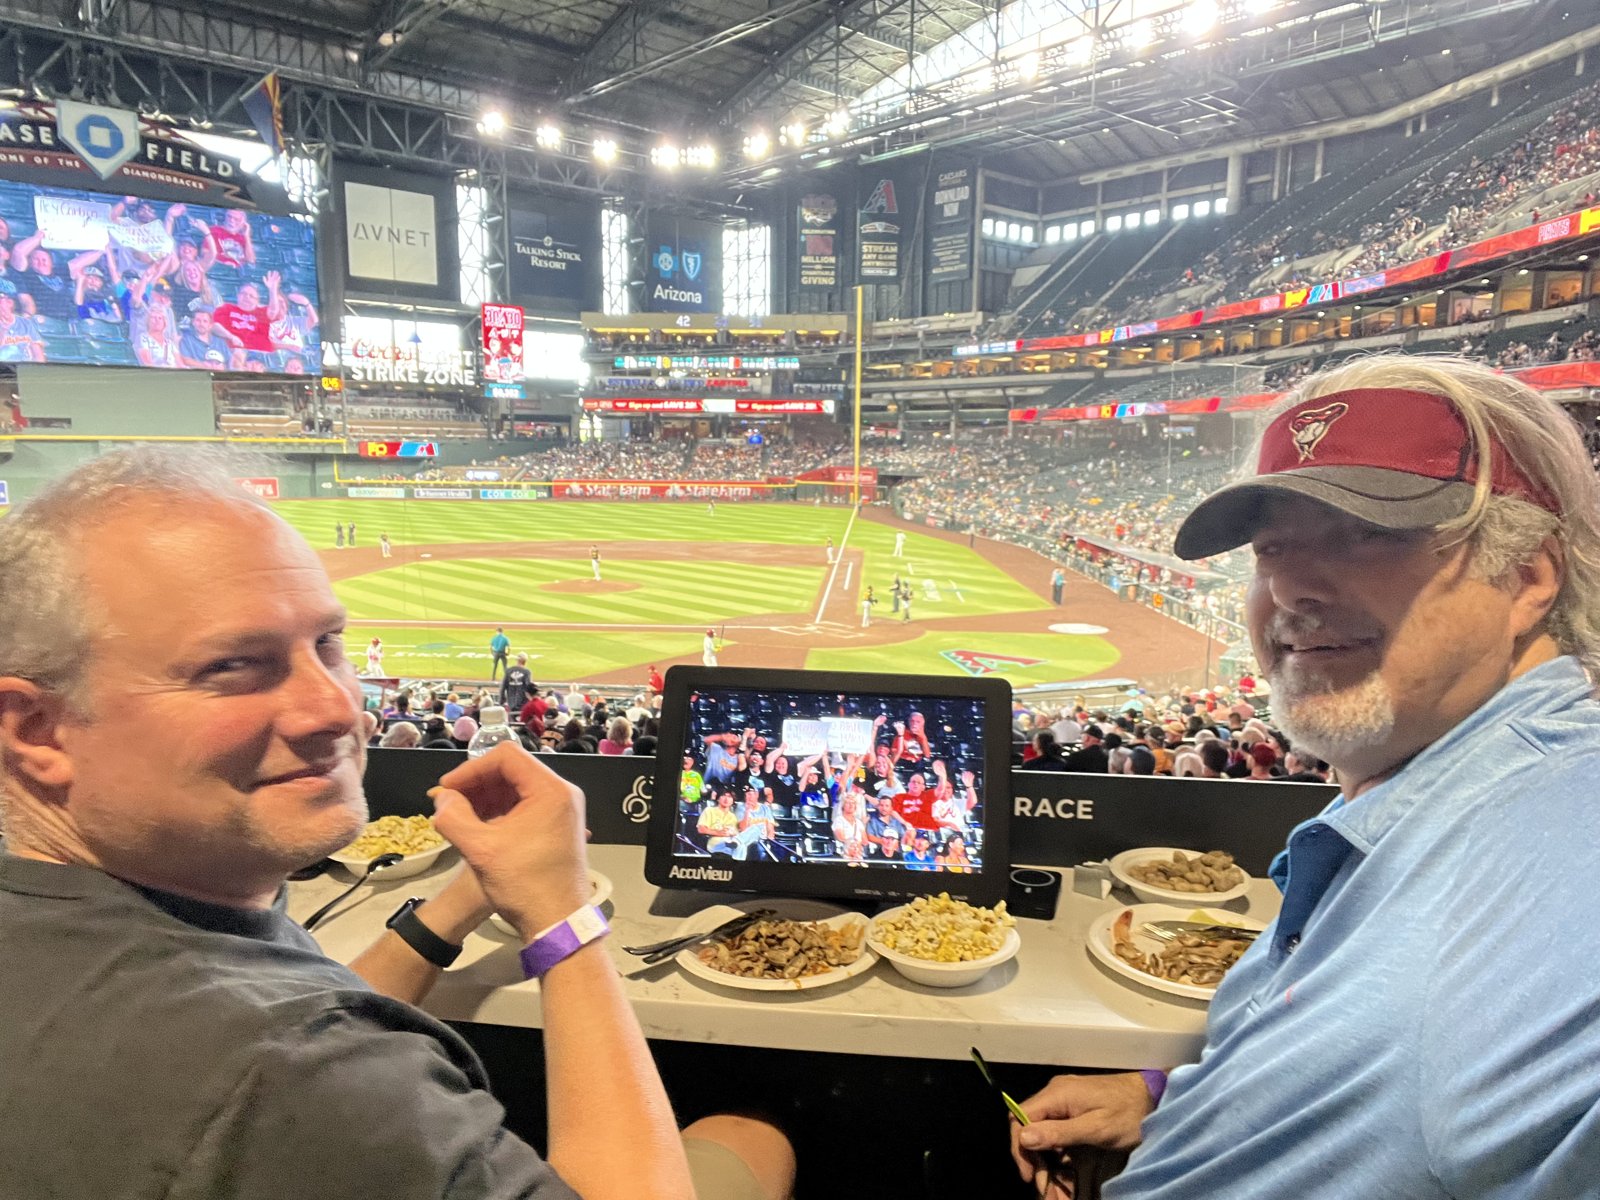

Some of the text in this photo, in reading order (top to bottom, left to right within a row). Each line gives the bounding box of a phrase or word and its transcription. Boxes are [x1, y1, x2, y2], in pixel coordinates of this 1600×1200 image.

[146, 142, 234, 178] FIELD
[57, 157, 81, 169] THE
[122, 166, 206, 191] DIAMONDBACKS
[353, 222, 430, 248] AVNET
[514, 242, 582, 262] TALKING STICK
[862, 245, 898, 253] STREAM
[530, 255, 566, 270] RESORT
[801, 256, 836, 264] MILLION
[801, 277, 836, 285] GIVING
[653, 284, 702, 304] Arizona
[676, 315, 691, 328] 42
[351, 365, 475, 386] STRIKE ZONE
[1014, 797, 1094, 820] RACE
[669, 865, 733, 882] AccuView
